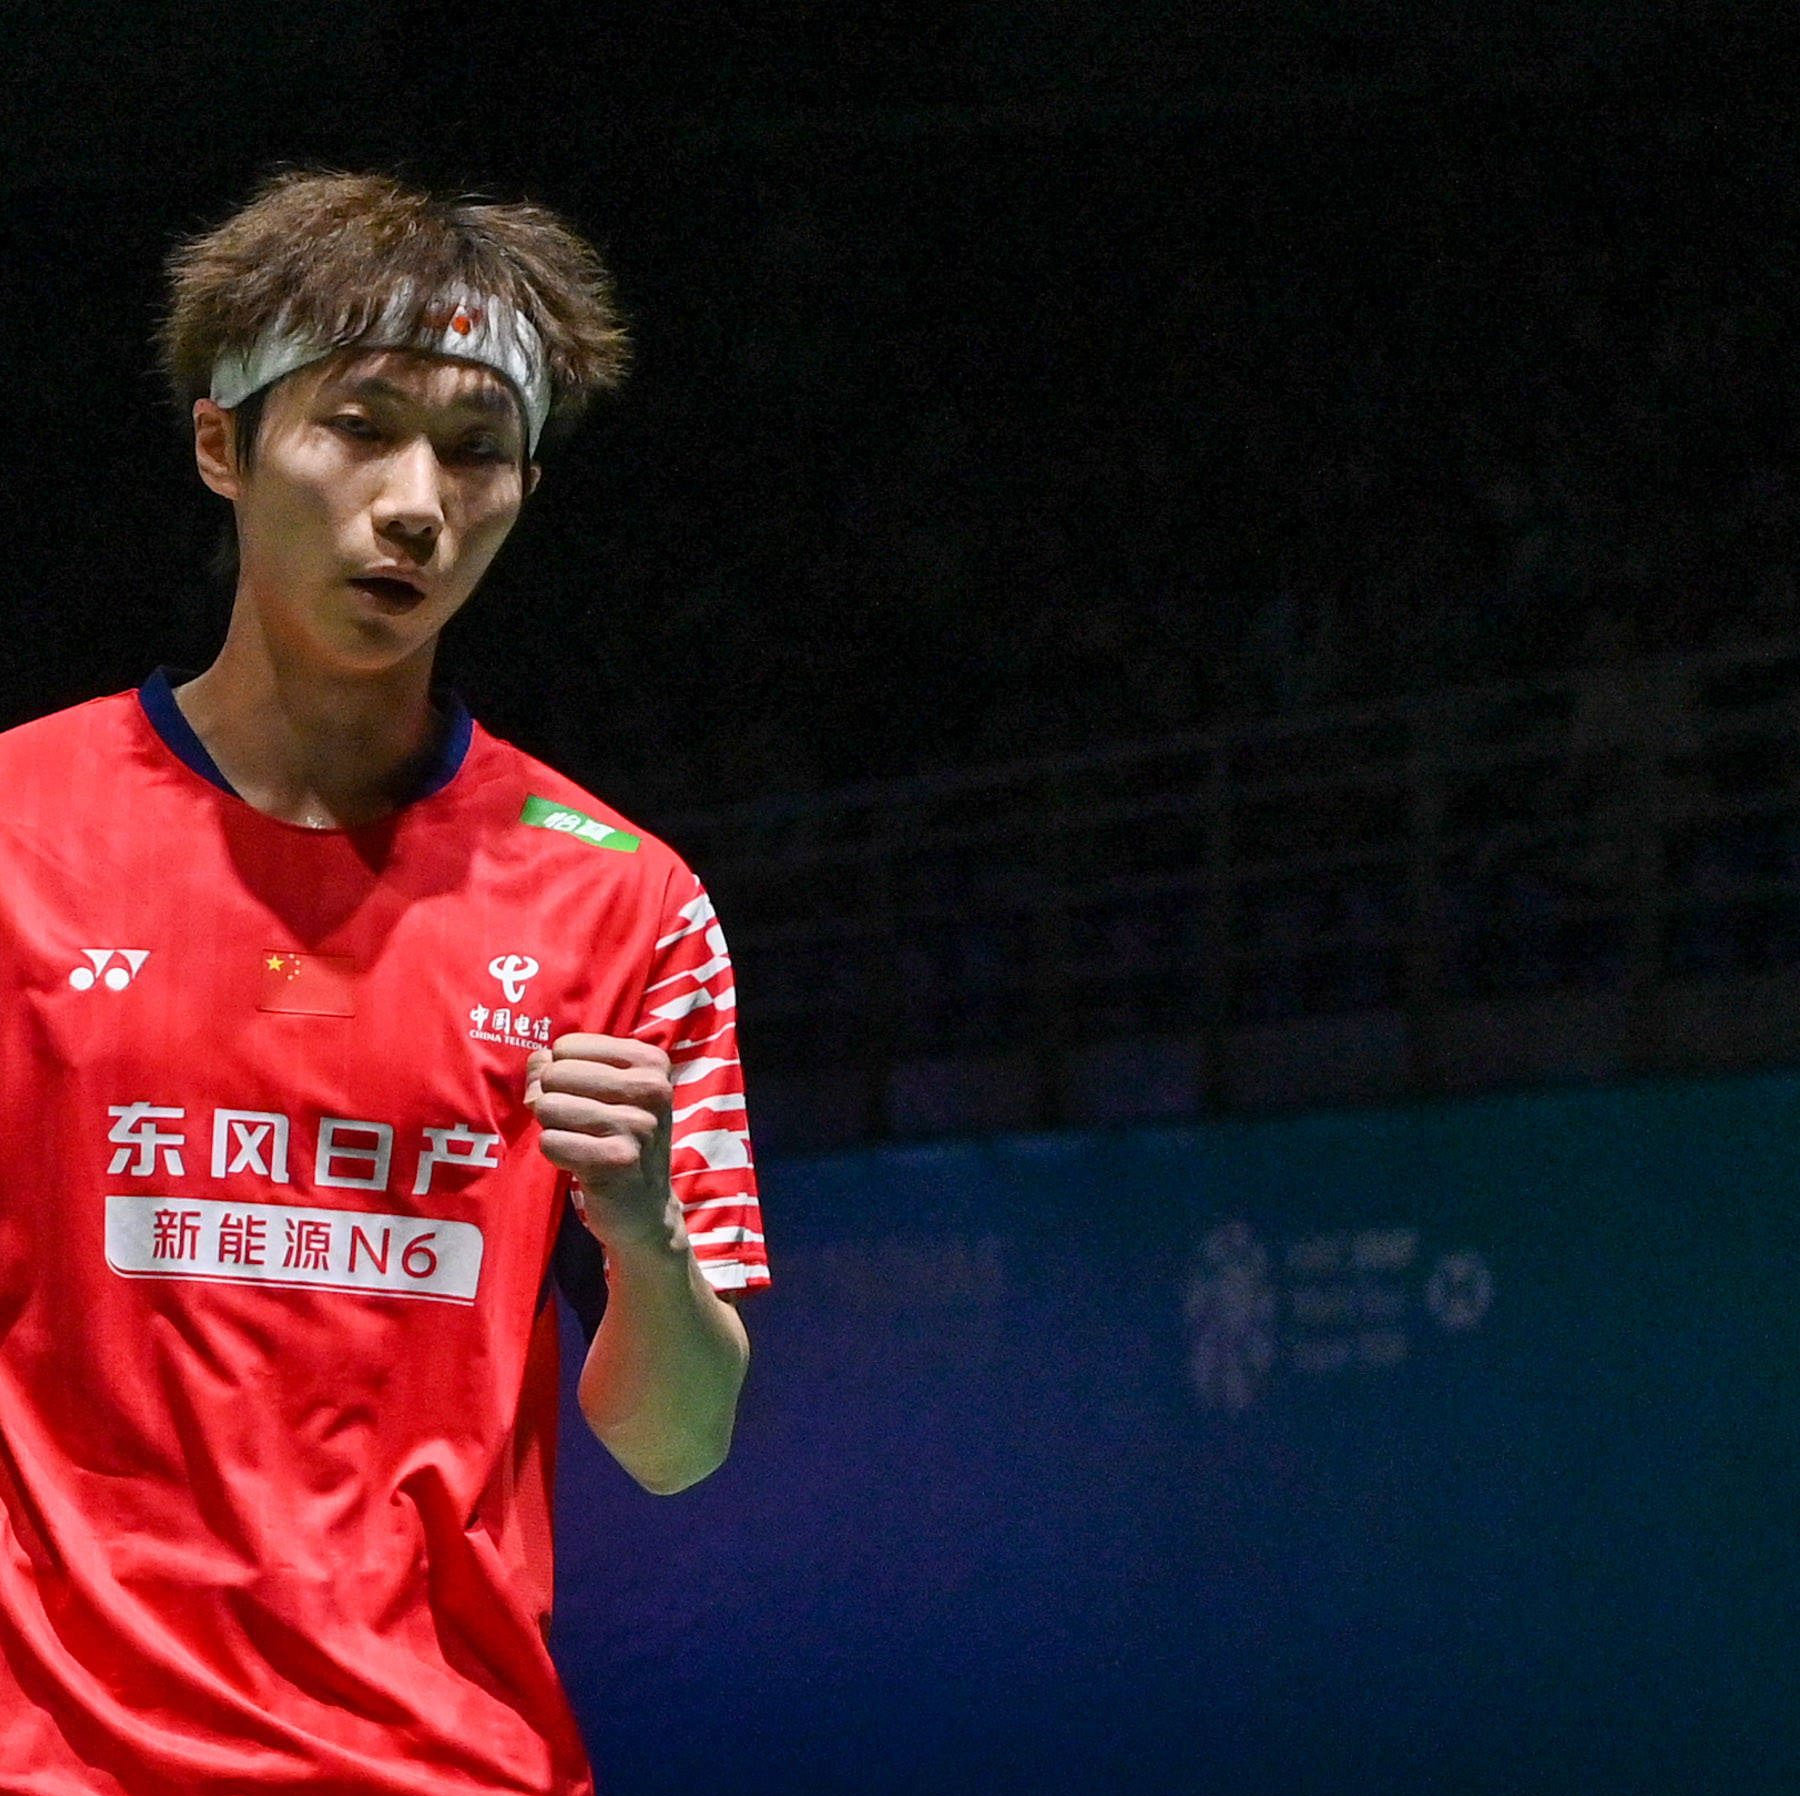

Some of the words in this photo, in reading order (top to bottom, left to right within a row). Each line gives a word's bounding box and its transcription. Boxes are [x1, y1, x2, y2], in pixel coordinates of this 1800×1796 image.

[469, 1003, 552, 1041] 中国电信
[469, 1029, 502, 1043] CHINA
[106, 1101, 500, 1196] 东风日产
[152, 1208, 438, 1279] 新能源N6
